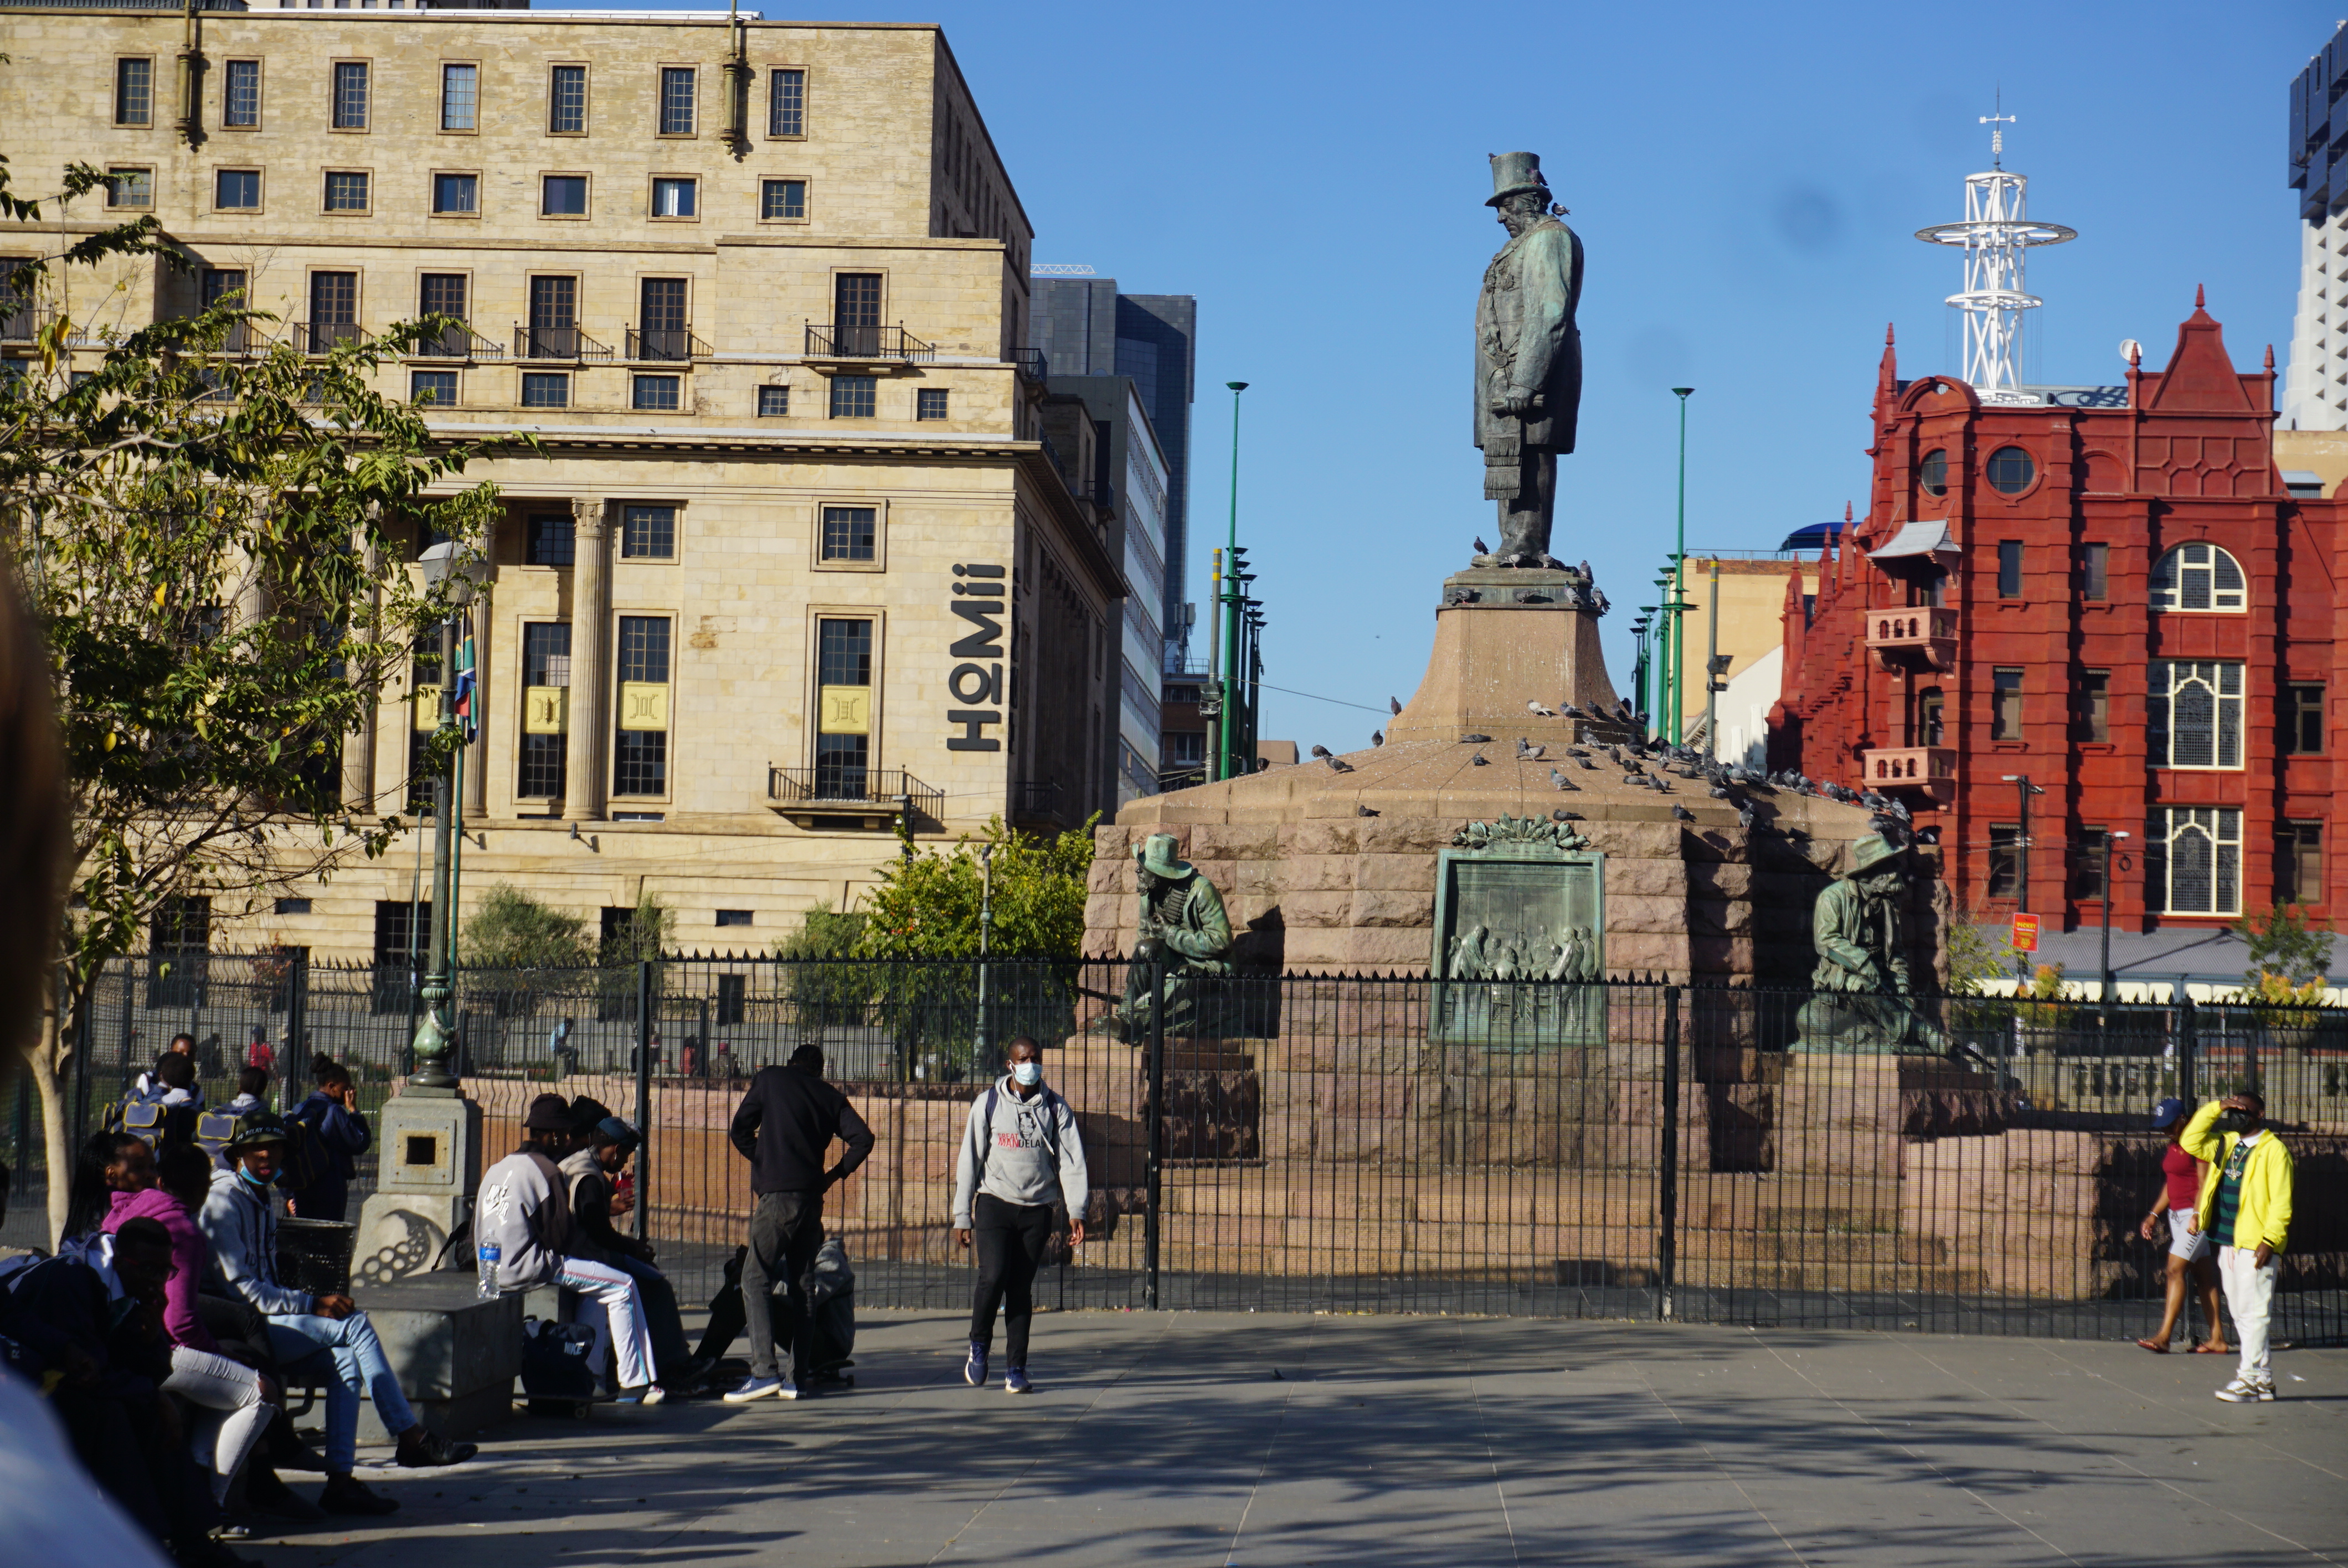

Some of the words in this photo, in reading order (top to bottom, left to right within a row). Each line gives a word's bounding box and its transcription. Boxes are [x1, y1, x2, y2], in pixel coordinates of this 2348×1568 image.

[947, 564, 1004, 751] HOMii
[246, 1127, 263, 1136] RELAY
[998, 1138, 1041, 1148] MANDELA
[564, 1342, 583, 1355] NIKE
